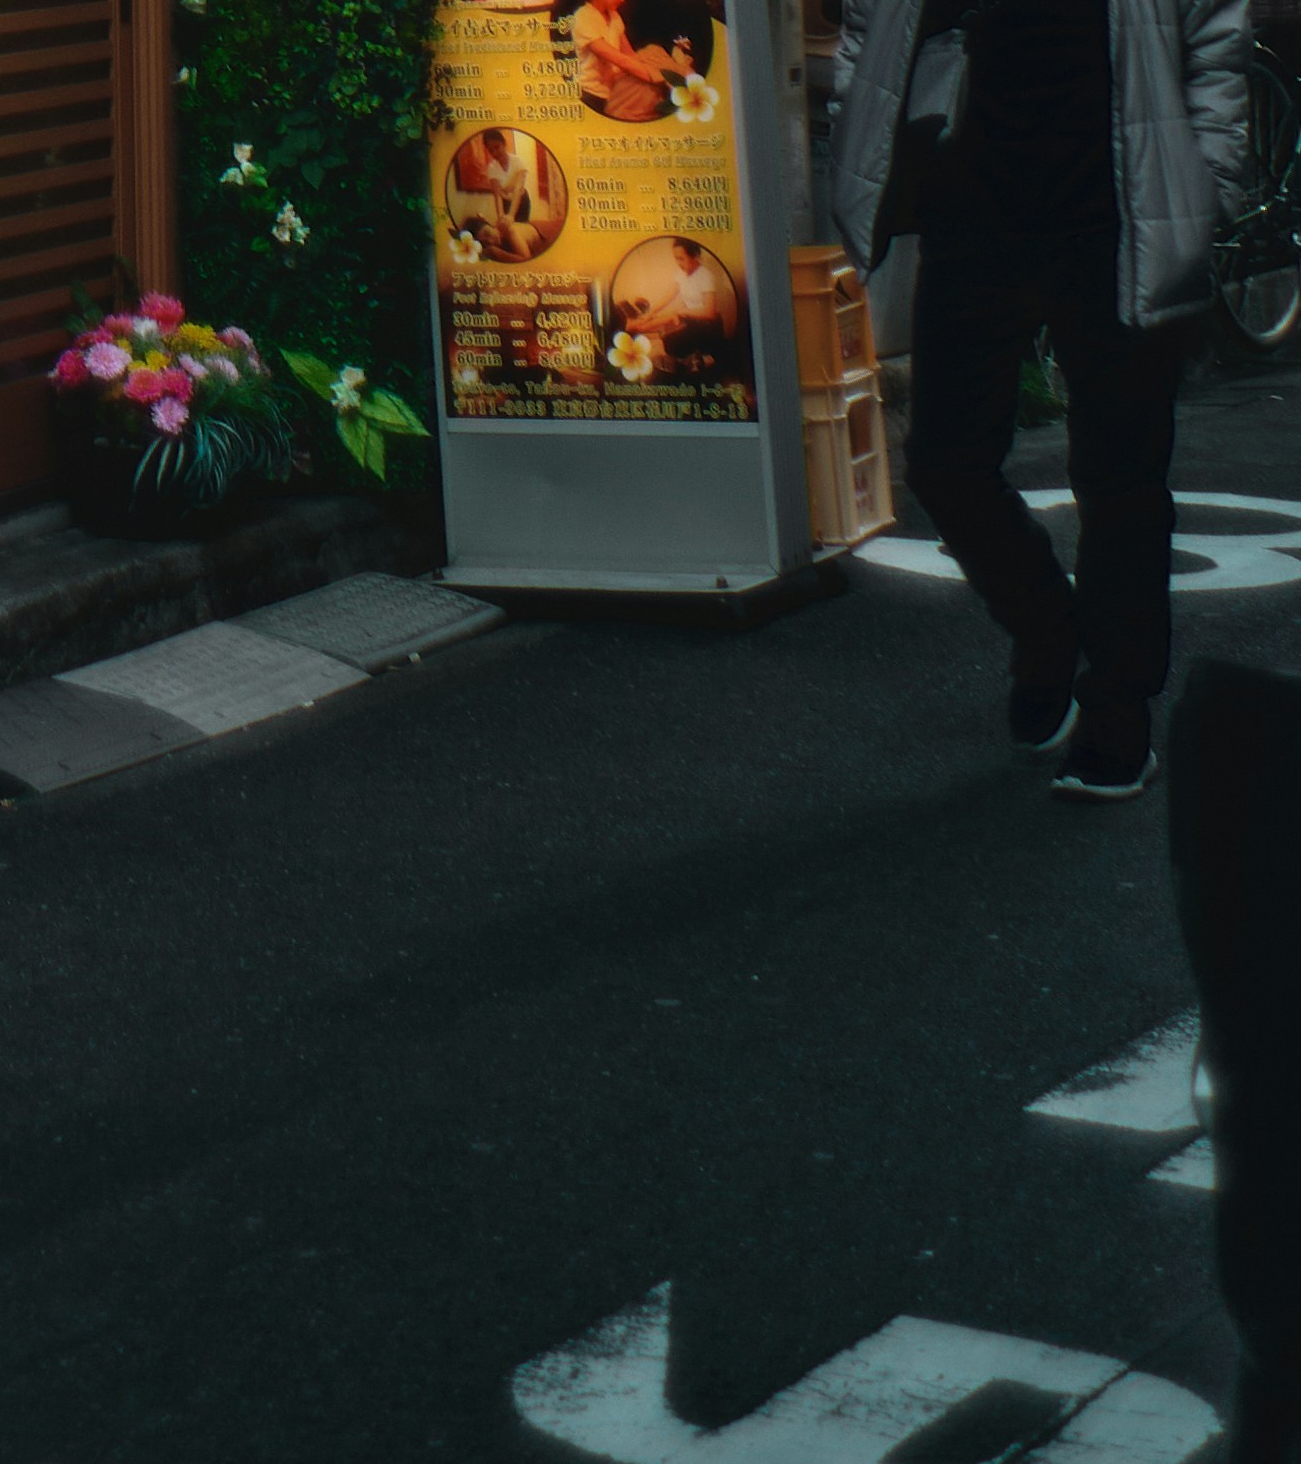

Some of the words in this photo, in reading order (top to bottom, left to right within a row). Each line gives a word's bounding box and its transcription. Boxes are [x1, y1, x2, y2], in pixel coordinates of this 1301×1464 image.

[443, 14, 574, 35] イ古式マッサージ
[576, 177, 626, 192] 60min
[577, 196, 628, 211] 90min
[580, 215, 639, 230] 120min
